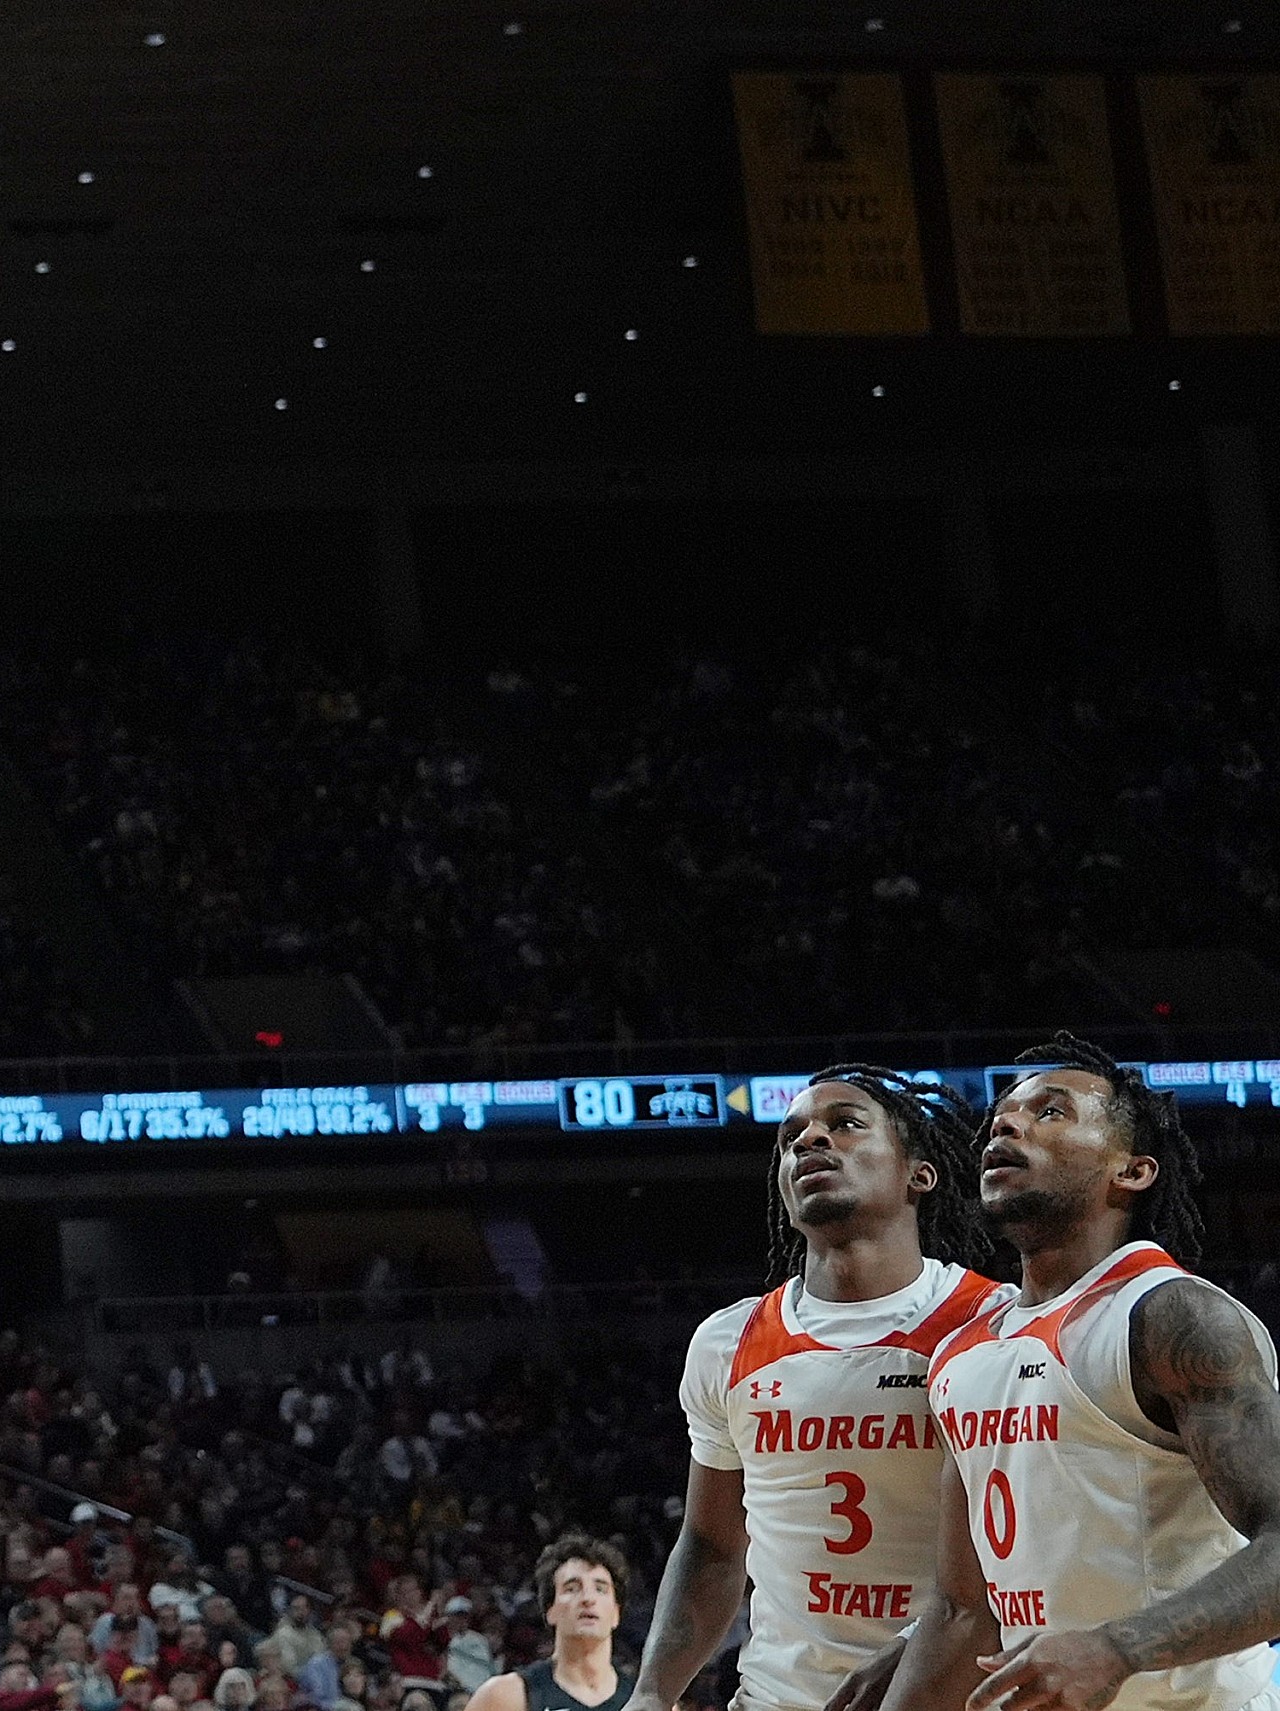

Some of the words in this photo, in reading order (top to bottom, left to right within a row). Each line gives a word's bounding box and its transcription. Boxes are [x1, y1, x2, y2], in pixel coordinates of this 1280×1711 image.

[974, 197, 1093, 226] NCAA
[573, 1078, 635, 1128] 80
[875, 1374, 928, 1390] MEAC
[939, 1405, 1059, 1455] MORGAN
[822, 1471, 873, 1555] 3
[983, 1468, 1016, 1560] 0
[801, 1571, 913, 1619] STATE
